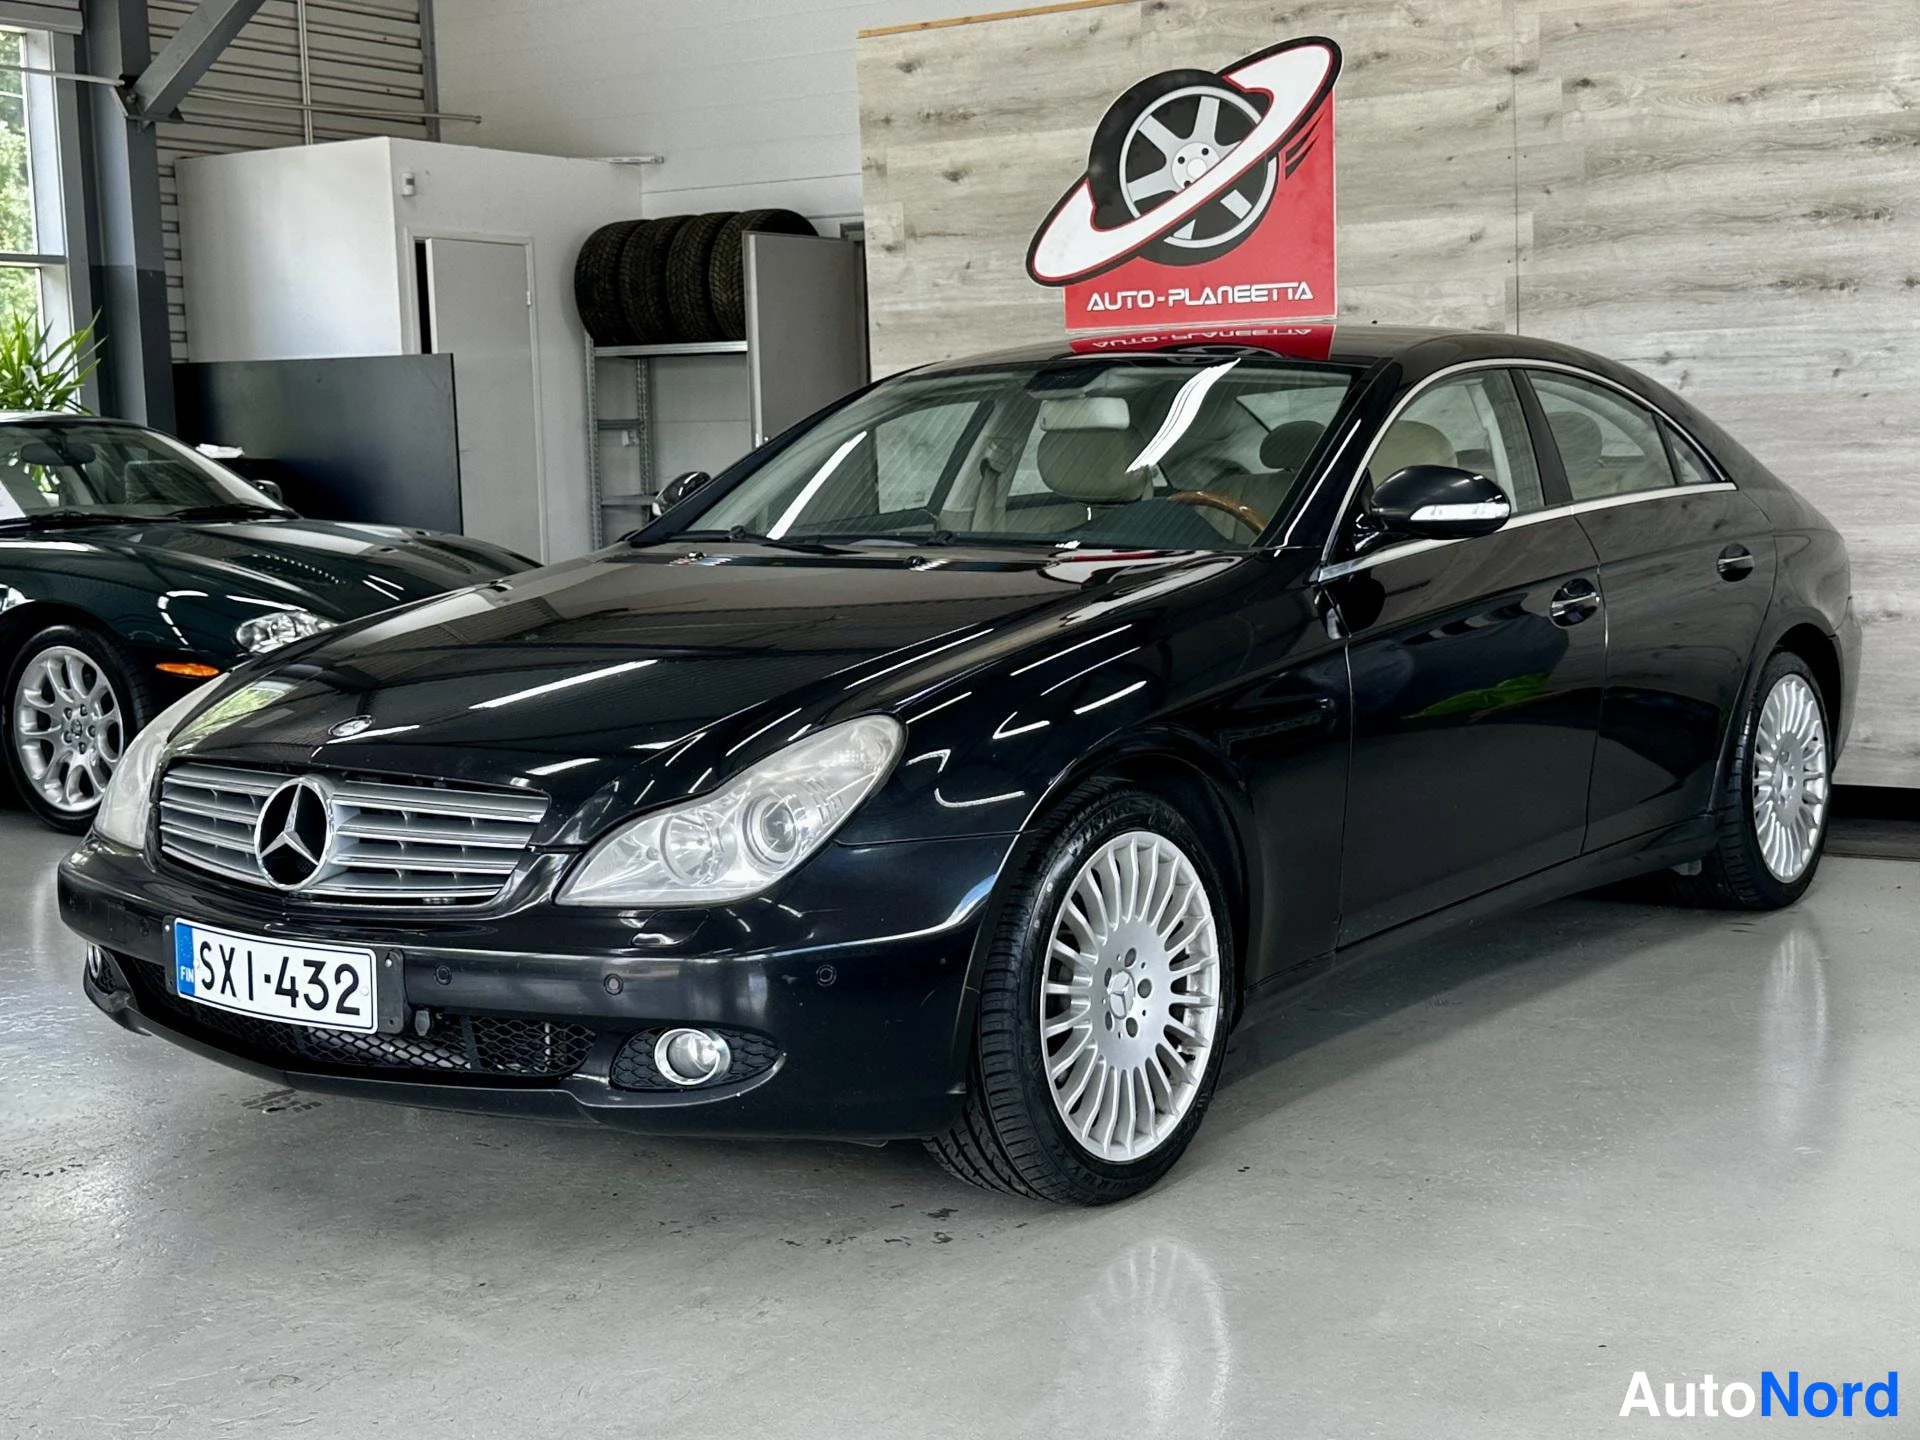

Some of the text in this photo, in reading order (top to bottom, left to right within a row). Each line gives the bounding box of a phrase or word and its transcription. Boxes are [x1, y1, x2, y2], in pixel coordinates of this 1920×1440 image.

[1086, 281, 1314, 312] AUTO-PLANEETTA
[180, 965, 195, 984] FIN
[199, 940, 361, 1016] SXI-432
